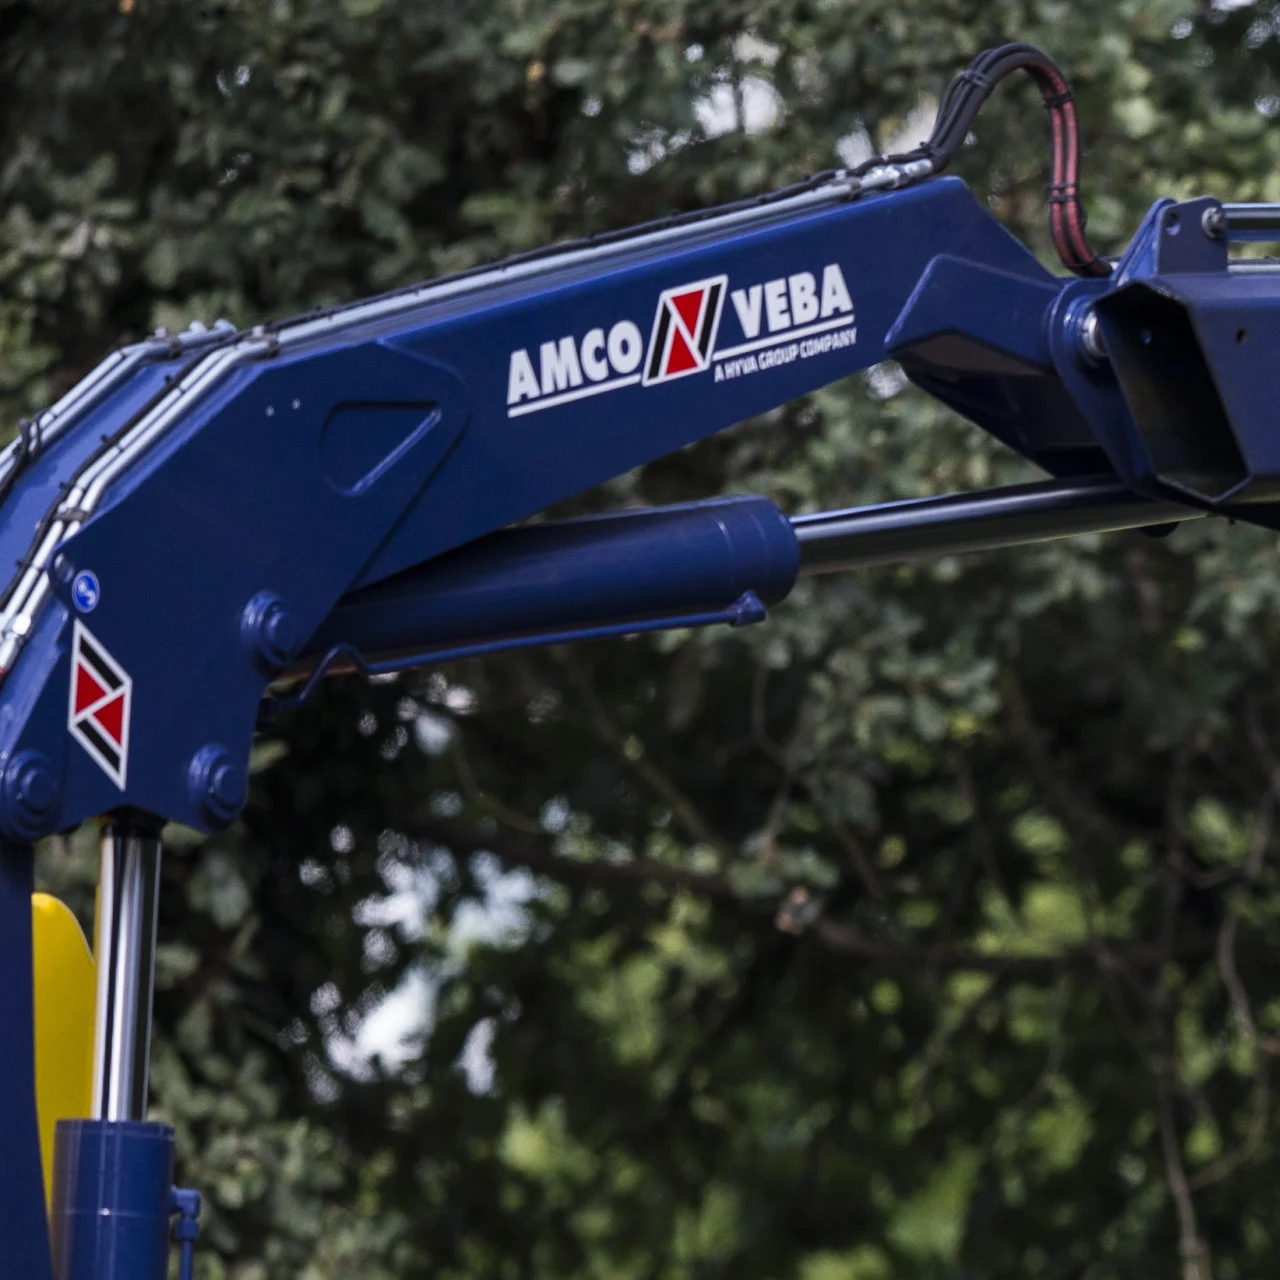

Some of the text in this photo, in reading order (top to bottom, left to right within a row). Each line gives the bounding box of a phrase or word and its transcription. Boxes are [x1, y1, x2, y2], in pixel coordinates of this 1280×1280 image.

[507, 263, 854, 405] AMCO VEBA
[714, 327, 858, 383] A HYVA GROUP COMPANY
